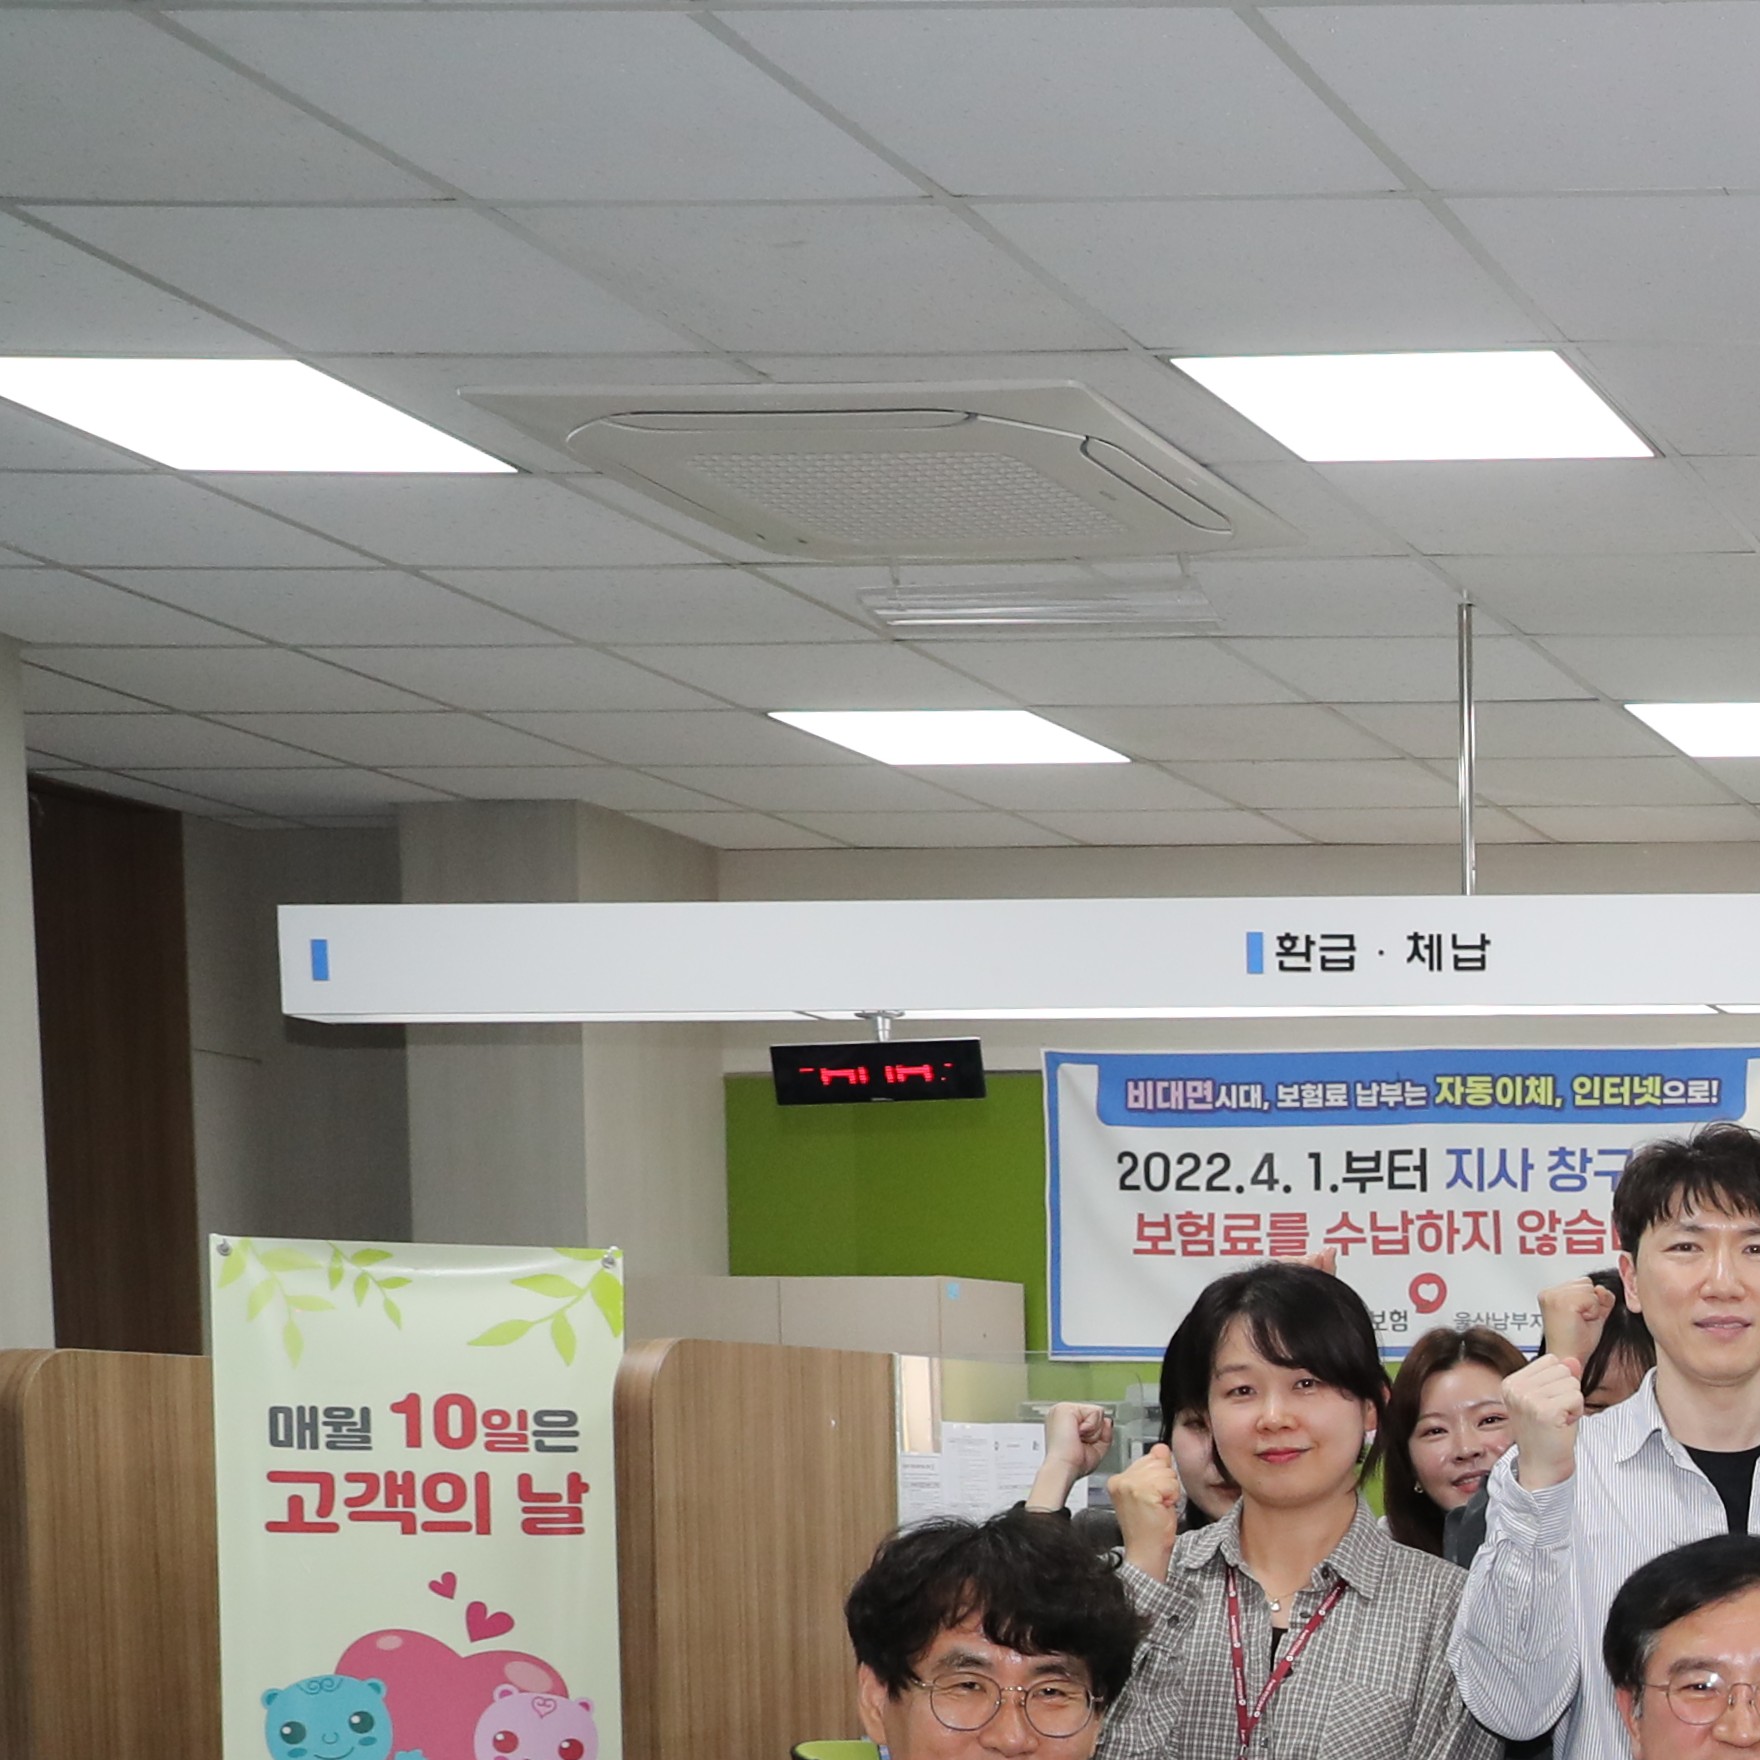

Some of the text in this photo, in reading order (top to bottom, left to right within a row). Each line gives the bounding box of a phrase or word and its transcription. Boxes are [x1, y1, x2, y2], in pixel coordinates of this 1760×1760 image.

[1274, 932, 1357, 973] 환급
[1406, 931, 1491, 972] 체납
[1275, 1081, 1349, 1111] 보험료
[1355, 1078, 1429, 1109] 납부는
[1433, 1073, 1564, 1109] 자동이체,
[1571, 1073, 1719, 1107] 인터넷으로!
[1445, 1147, 1534, 1193] 지사
[1547, 1146, 1634, 1193] 창구
[1132, 1207, 1621, 1258] 보험료를 수납하지 않습
[268, 1392, 580, 1454] 매월 10일은
[264, 1470, 590, 1536] 고객의 날
